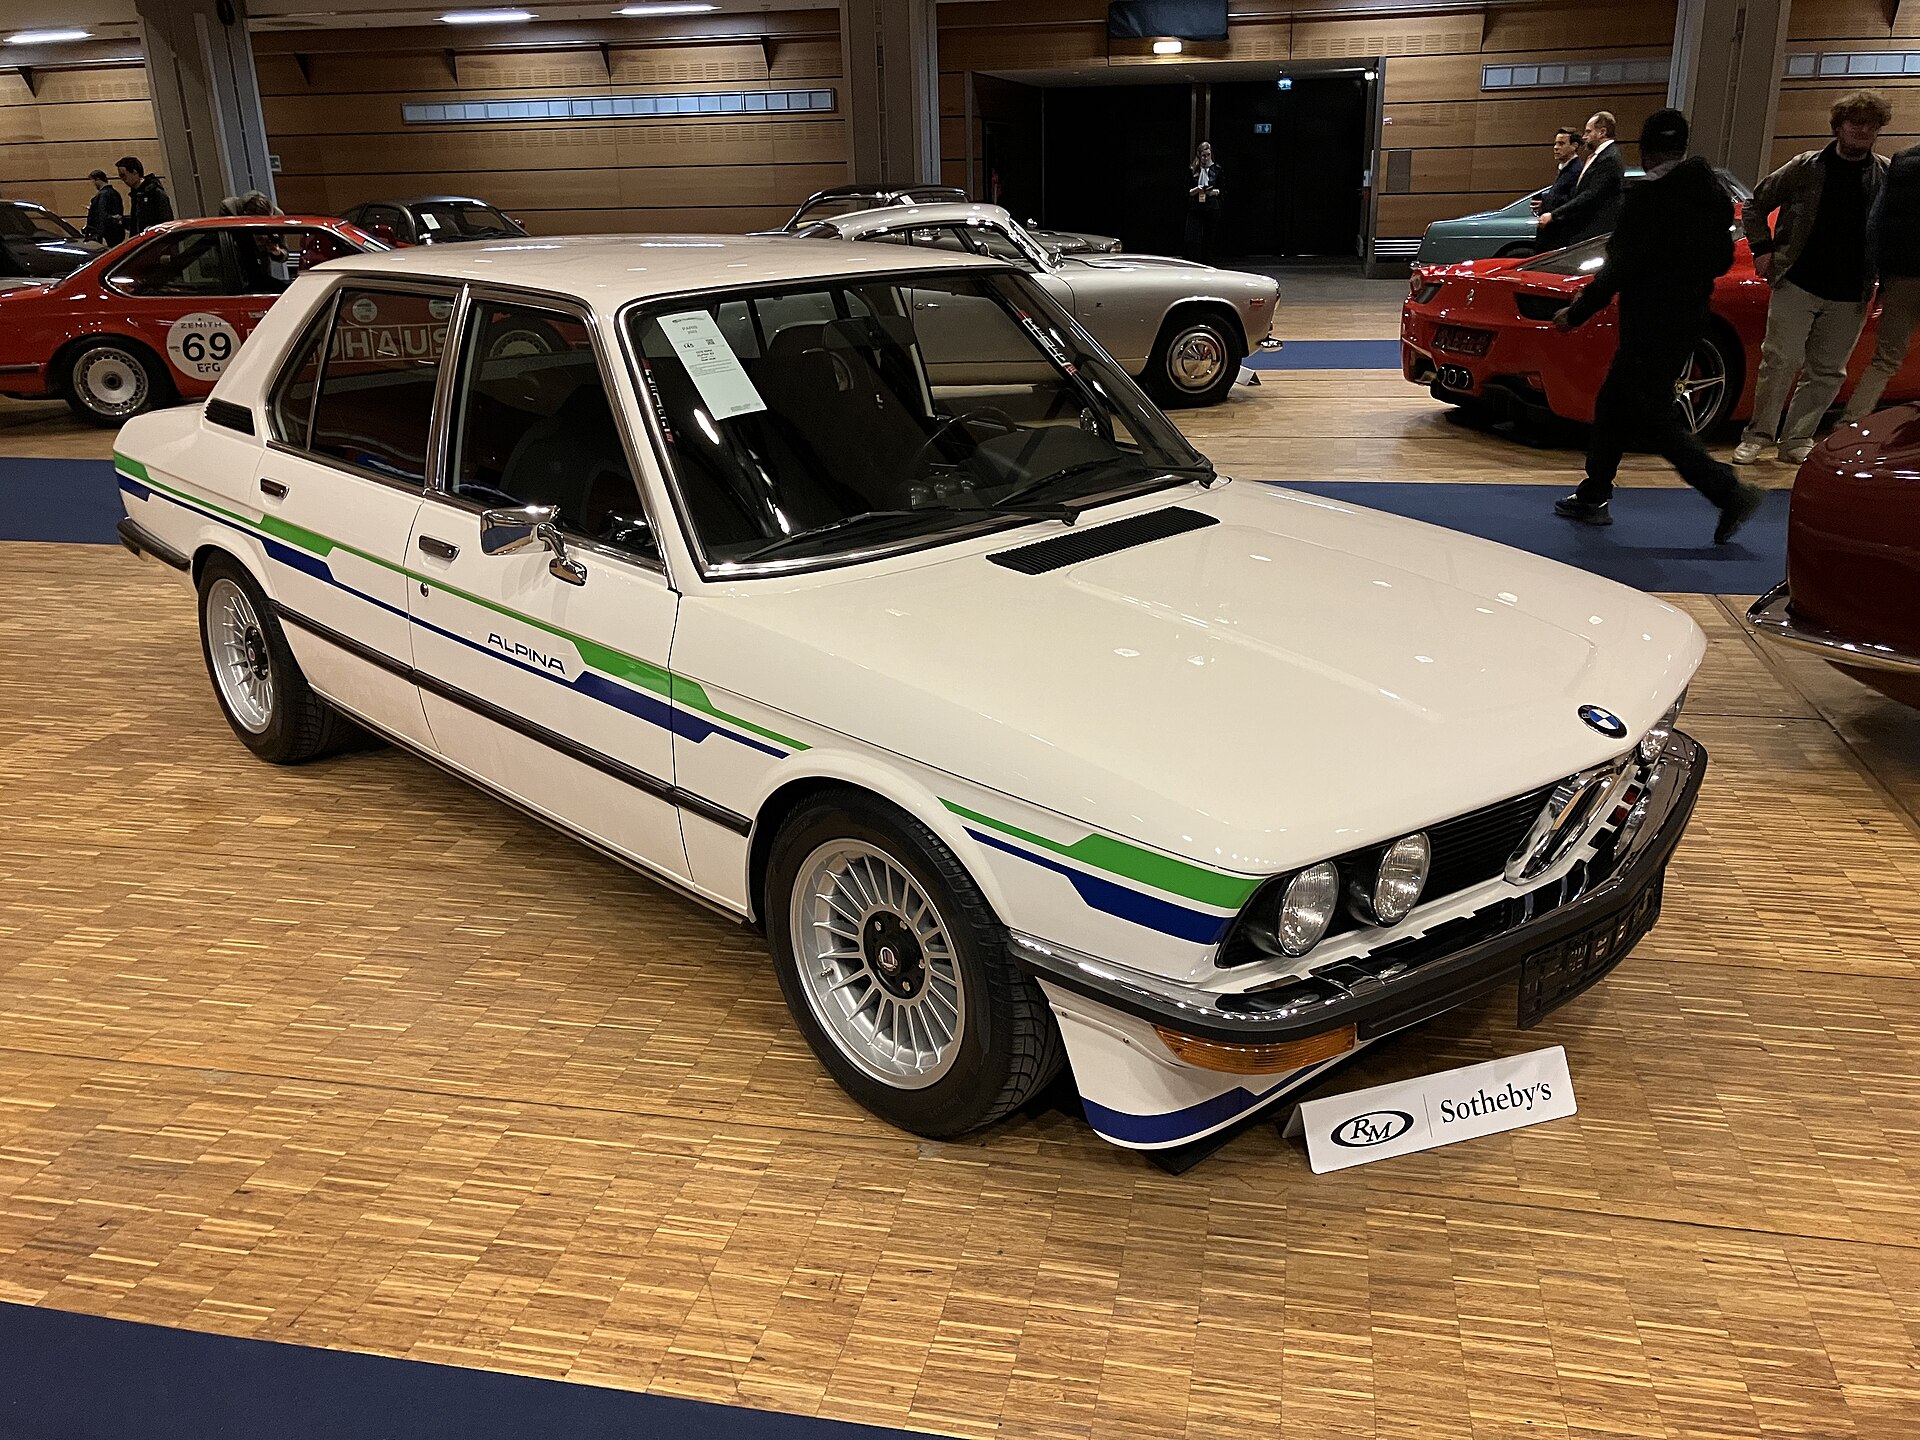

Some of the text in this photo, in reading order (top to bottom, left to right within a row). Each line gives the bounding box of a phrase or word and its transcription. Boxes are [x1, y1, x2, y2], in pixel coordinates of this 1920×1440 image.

[182, 332, 232, 361] 69
[197, 363, 221, 372] EFG
[488, 633, 565, 674] ALPINA
[1350, 1082, 1552, 1143] RM Sotheby's
